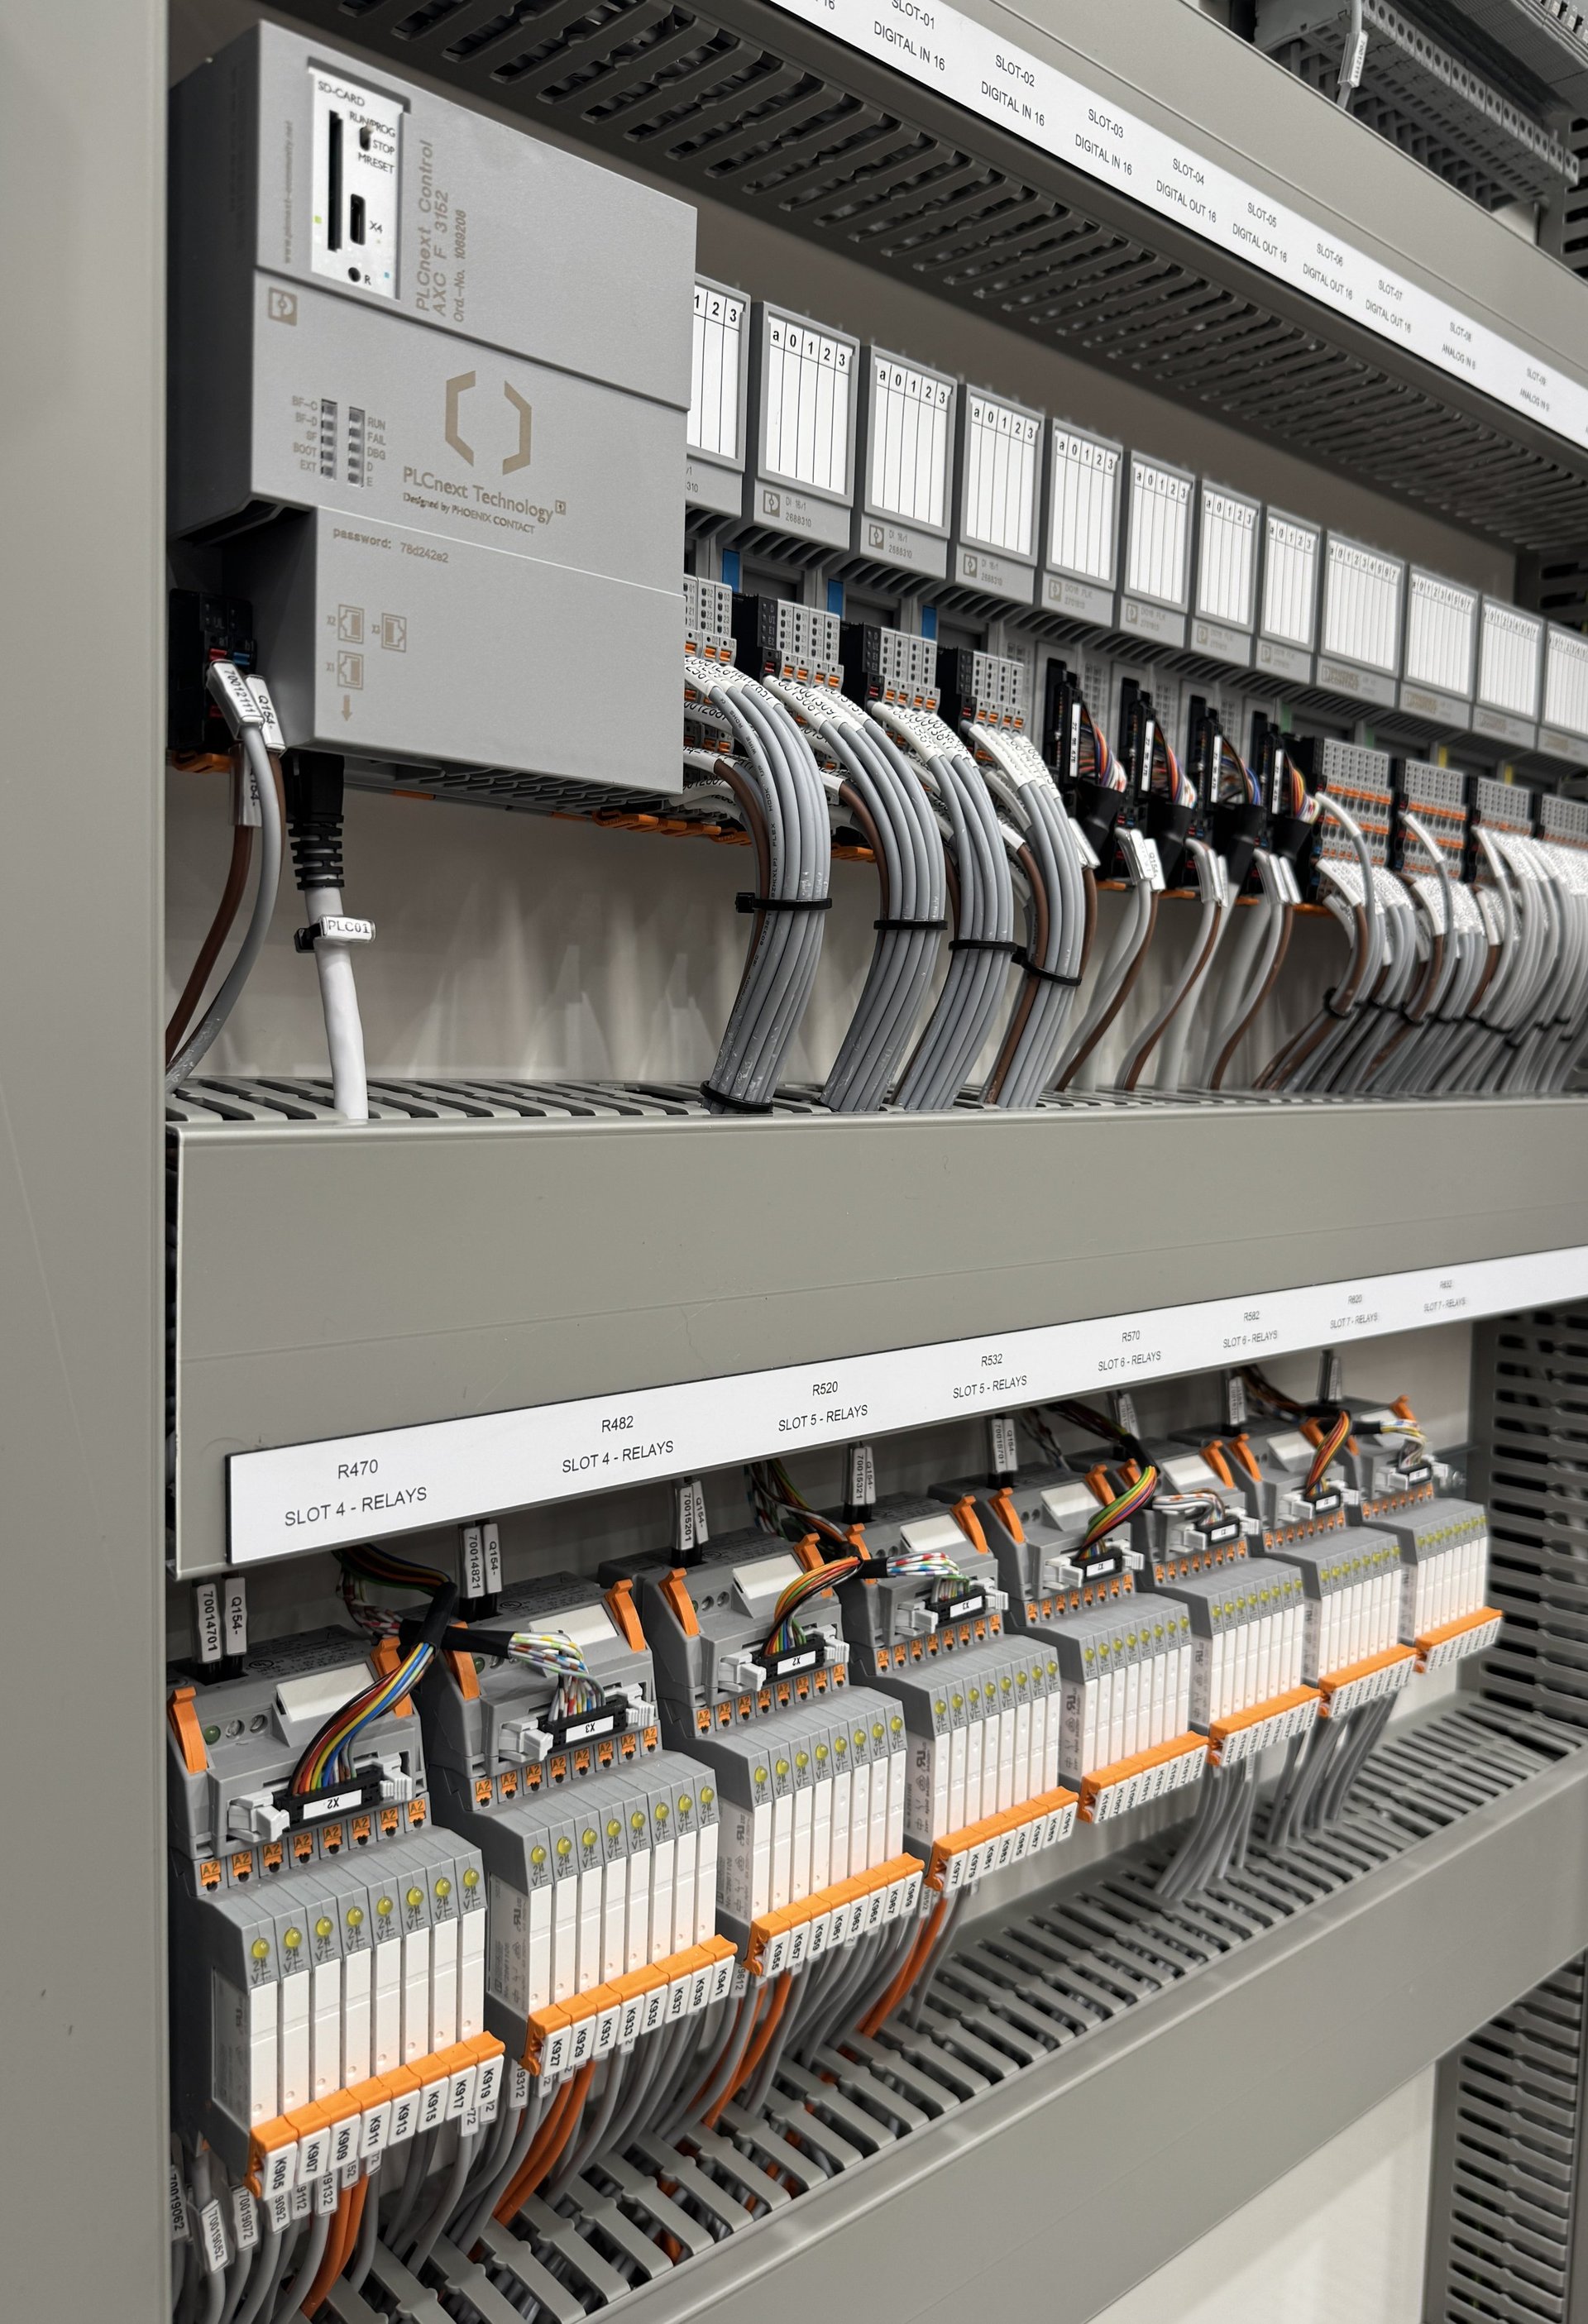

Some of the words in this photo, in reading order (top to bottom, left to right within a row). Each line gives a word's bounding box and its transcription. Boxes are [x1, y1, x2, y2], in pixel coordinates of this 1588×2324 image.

[891, 0, 934, 30] SLOT-01
[874, 21, 917, 56] DIGITAL
[920, 46, 930, 63] IN
[934, 55, 945, 71] 16
[995, 55, 1035, 87] SLOT-02
[318, 81, 365, 107] SD-CARD
[981, 81, 1019, 113] DIGITAL
[1022, 103, 1031, 120] IN
[1035, 112, 1045, 127] 16
[1088, 109, 1124, 139] SLOT-03
[373, 140, 395, 155] STOP
[1075, 134, 1109, 163] DIGITAL
[1112, 154, 1120, 169] IN
[1123, 162, 1132, 176] 16
[358, 152, 395, 174] MRESET
[419, 140, 433, 213] Control
[1173, 158, 1204, 185] SLOT-04
[435, 190, 449, 233] 3152
[1156, 179, 1187, 207] DIGITAL
[1189, 199, 1206, 216] OUT
[1208, 210, 1216, 223] 16
[1247, 202, 1277, 228] SLOT-05
[370, 220, 383, 234] X4
[434, 245, 447, 260] F
[1232, 223, 1260, 248] DIGITAL
[1263, 241, 1278, 256] OUT
[1280, 251, 1287, 263] 16
[1316, 243, 1343, 266] SLOT-06
[364, 275, 371, 285] R
[416, 227, 431, 311] PLCnext
[1303, 263, 1328, 287] DIGITAL
[1330, 279, 1344, 294] OUT
[1346, 288, 1353, 300] 16
[433, 272, 447, 317] AXC
[712, 302, 720, 316] 2
[729, 308, 737, 322] 3
[772, 330, 780, 342] a
[790, 335, 796, 347] 0
[808, 342, 814, 355] 1
[824, 348, 830, 361] 2
[839, 353, 846, 366] 3
[880, 369, 886, 380] a
[895, 374, 902, 387] 0
[911, 380, 916, 393] 1
[926, 386, 932, 399] 2
[939, 392, 946, 404] 3
[292, 395, 318, 411] BF-C
[306, 431, 317, 441] SF
[367, 417, 386, 431] RUN
[293, 442, 317, 457] BOOT
[367, 432, 386, 446] FAIL
[300, 459, 316, 473] EXT
[367, 447, 386, 460] DBG
[367, 461, 373, 472] D
[367, 476, 373, 487] E
[403, 466, 469, 500] PLCnext
[473, 484, 554, 525] Technology
[403, 493, 438, 511] Designed
[440, 502, 450, 514] by
[452, 504, 492, 524] PHOENIX
[493, 516, 536, 534] CONTACT
[333, 527, 392, 550] password:
[224, 670, 256, 713] 70012111
[328, 919, 370, 934] PLC01
[1244, 1311, 1260, 1321] R582
[1122, 1330, 1140, 1342] R570
[1223, 1336, 1241, 1348] SLOT
[1252, 1330, 1277, 1343] RELAYS
[981, 1353, 1003, 1367] R532
[1098, 1358, 1119, 1372] SLOT
[1120, 1357, 1125, 1367] 6
[1131, 1351, 1161, 1365] RELAYS
[812, 1381, 838, 1396] R520
[952, 1384, 978, 1399] SLOT
[979, 1383, 985, 1394] 5
[992, 1375, 1027, 1392] RELAYS
[602, 1415, 634, 1433] R482
[778, 1415, 808, 1432] SLOT
[810, 1414, 817, 1426] 5
[827, 1404, 868, 1423] RELAYS
[338, 1458, 378, 1479] R470
[562, 1454, 599, 1473] SLOT
[602, 1452, 610, 1465] 4
[622, 1440, 674, 1462] RELAYS
[285, 1504, 331, 1527] SLOT
[335, 1502, 346, 1517] 4
[362, 1487, 427, 1512] RELAYS
[696, 1497, 704, 1527] Q154-
[469, 1535, 481, 1589] 70014821
[490, 1541, 498, 1576] Q154-
[203, 1591, 218, 1652] 70014701
[231, 1597, 243, 1635] Q154-
[792, 1656, 801, 1666] X2
[585, 1721, 595, 1734] X3
[327, 1797, 340, 1810] X2
[409, 1801, 423, 1812] A2
[324, 1827, 339, 1839] A2
[202, 1865, 218, 1876] A2
[869, 1897, 880, 1924] K965
[888, 1889, 899, 1914] K967
[832, 1914, 844, 1941] K961
[851, 1905, 862, 1932] K963
[792, 1932, 804, 1960] K957
[812, 1923, 824, 1951] K959
[771, 1941, 784, 1970] K955
[693, 1977, 705, 2007] K939
[715, 1967, 727, 1996] K941
[646, 1996, 660, 2027] K935
[671, 1986, 684, 2014] K937
[599, 2018, 612, 2047] K931
[623, 2006, 636, 2037] K933
[550, 2037, 563, 2066] K927
[574, 2027, 588, 2058] K929
[453, 2079, 467, 2109] K917
[480, 2067, 494, 2099] K919
[396, 2103, 411, 2136] K913
[426, 2090, 440, 2123] K915
[336, 2127, 351, 2161] K909
[368, 2114, 382, 2147] K911
[305, 2142, 320, 2174] K907
[273, 2156, 287, 2190] K905
[170, 2173, 185, 2231] 70019062
[239, 2192, 254, 2240] 70019072
[208, 2209, 224, 2261] 70019052
